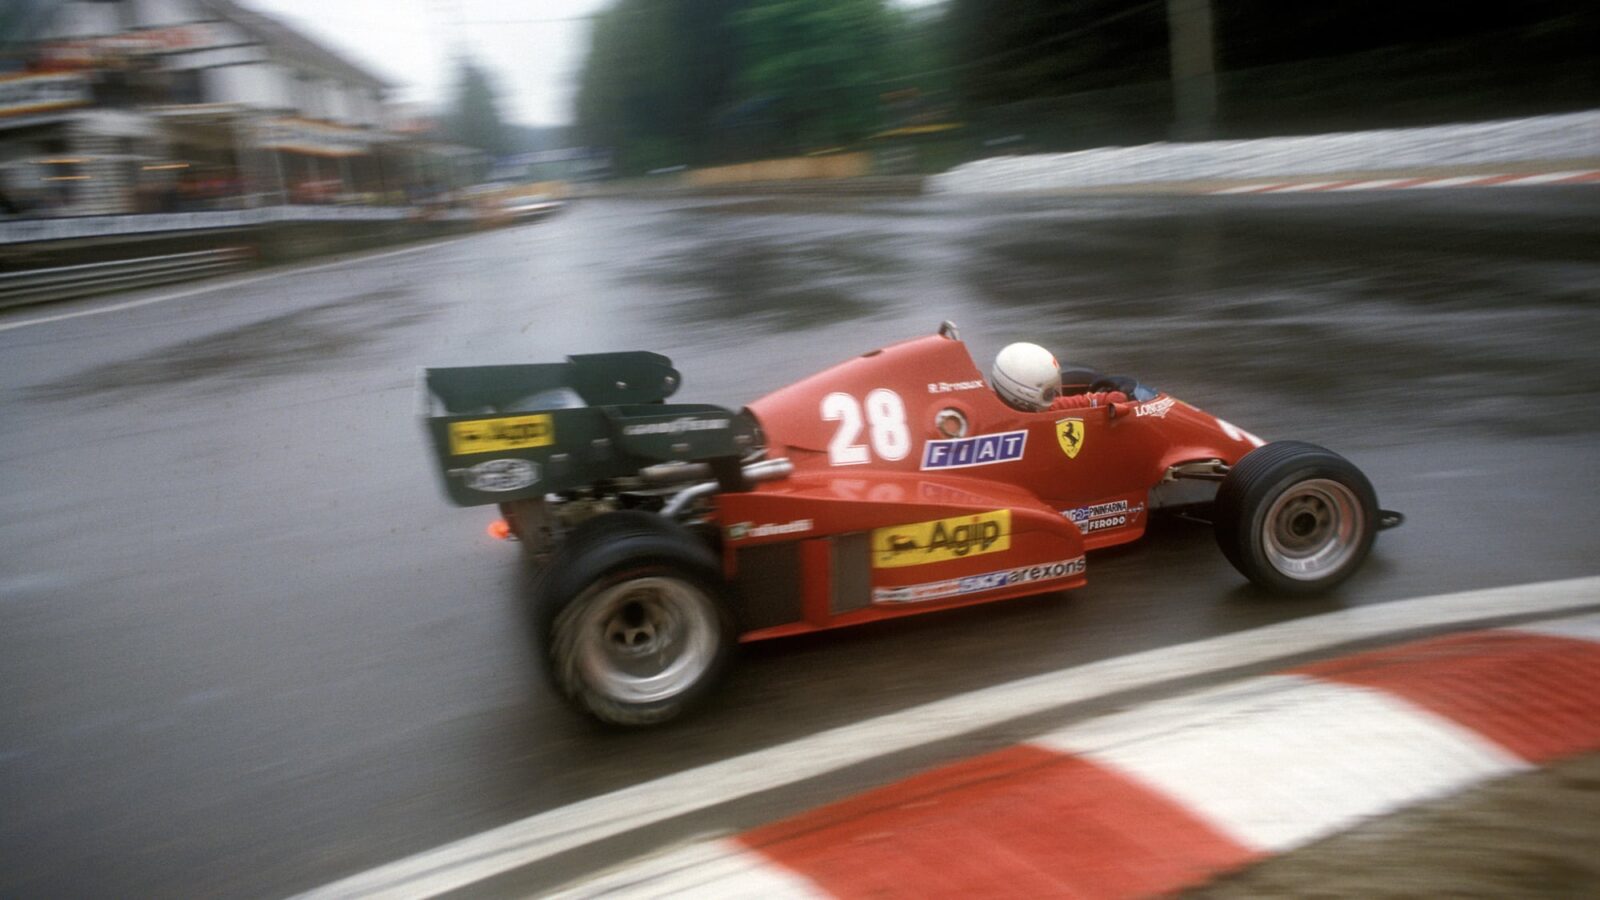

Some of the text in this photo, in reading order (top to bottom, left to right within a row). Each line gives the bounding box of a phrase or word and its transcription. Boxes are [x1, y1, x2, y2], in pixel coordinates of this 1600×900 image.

[820, 387, 912, 466] 28
[929, 436, 1022, 464] FIAT
[928, 516, 1001, 556] Agip
[1089, 516, 1126, 530] FERODO
[1007, 558, 1086, 584] arexons
